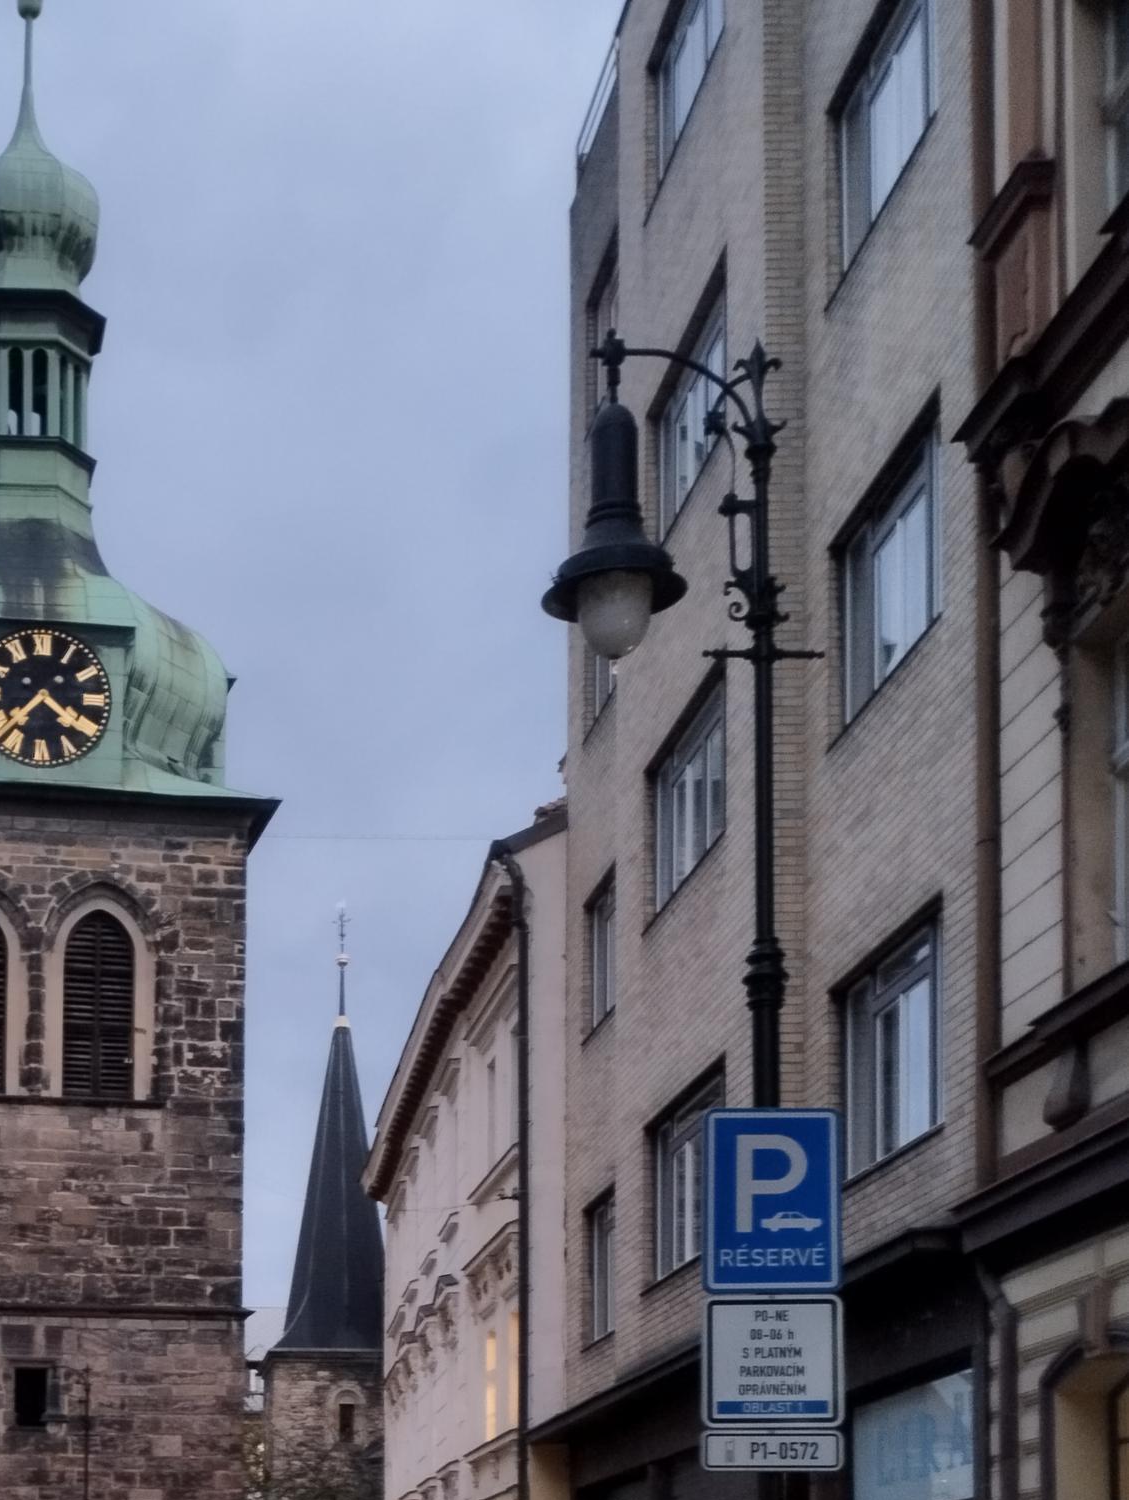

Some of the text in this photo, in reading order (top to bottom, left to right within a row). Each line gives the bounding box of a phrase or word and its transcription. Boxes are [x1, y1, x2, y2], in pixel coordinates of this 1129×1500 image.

[735, 1134, 808, 1233] P
[719, 1243, 825, 1267] RÉSERVÉ
[788, 1330, 794, 1339] h
[743, 1344, 802, 1358] S PLATNÝM
[740, 1363, 805, 1377] PARKOVACÍM
[739, 1381, 806, 1395] OPRÁVNĚNÍM
[743, 1403, 790, 1412] OBLAST
[750, 1442, 819, 1459] P1-0572
